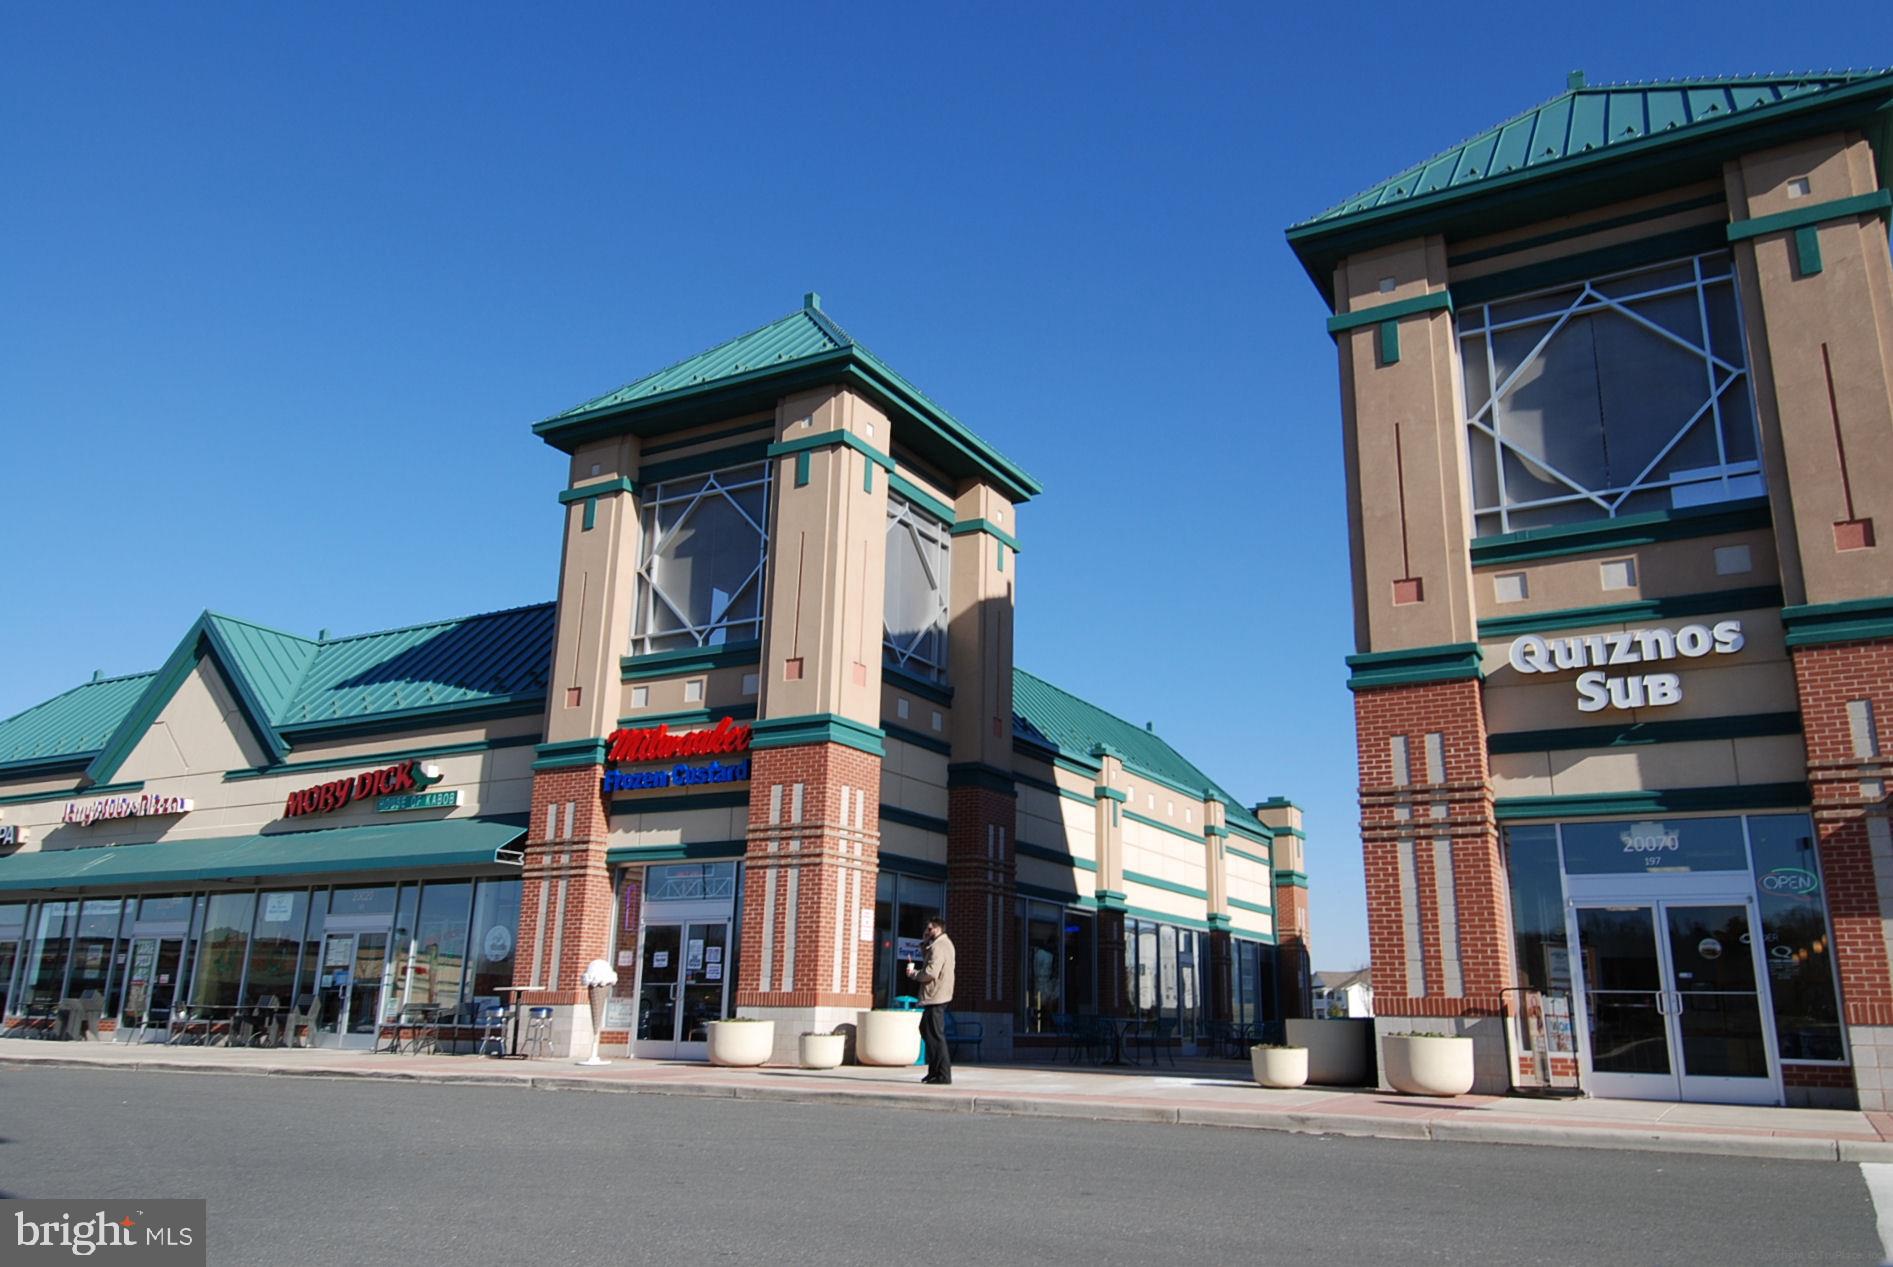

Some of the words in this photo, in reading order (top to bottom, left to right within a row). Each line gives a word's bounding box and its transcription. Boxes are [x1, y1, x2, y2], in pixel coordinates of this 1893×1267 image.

[603, 768, 671, 794] Frozen
[671, 758, 751, 786] Custard
[284, 777, 356, 818] MOBY
[355, 761, 414, 800] DICK
[425, 792, 456, 807] KABOB
[1622, 834, 1680, 853] 20070
[1763, 875, 1812, 890] OPEN
